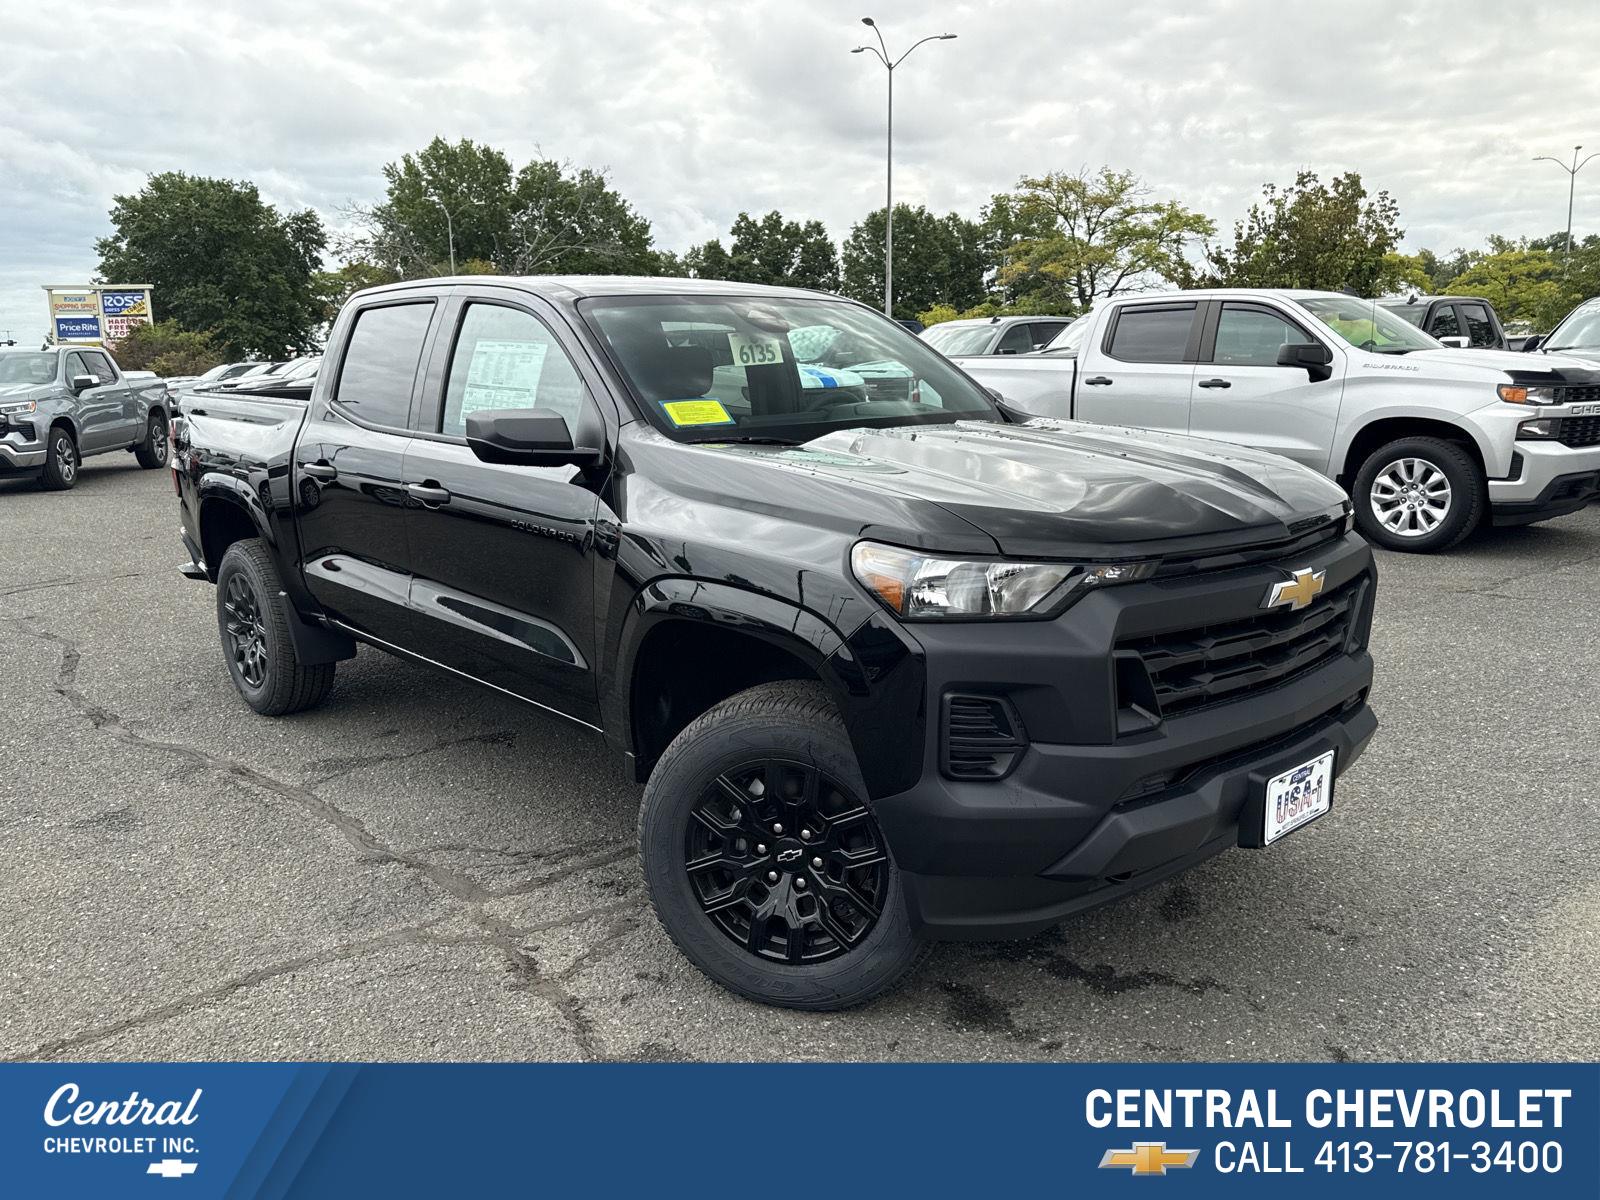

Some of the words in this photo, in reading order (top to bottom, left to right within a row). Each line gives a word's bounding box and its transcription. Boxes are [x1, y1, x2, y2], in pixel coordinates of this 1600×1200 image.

[104, 296, 143, 306] ROSS
[60, 323, 81, 331] Price
[82, 323, 98, 331] Rite
[740, 344, 776, 364] 6135
[1362, 363, 1420, 371] SILVERADO
[1276, 774, 1323, 824] USA-1
